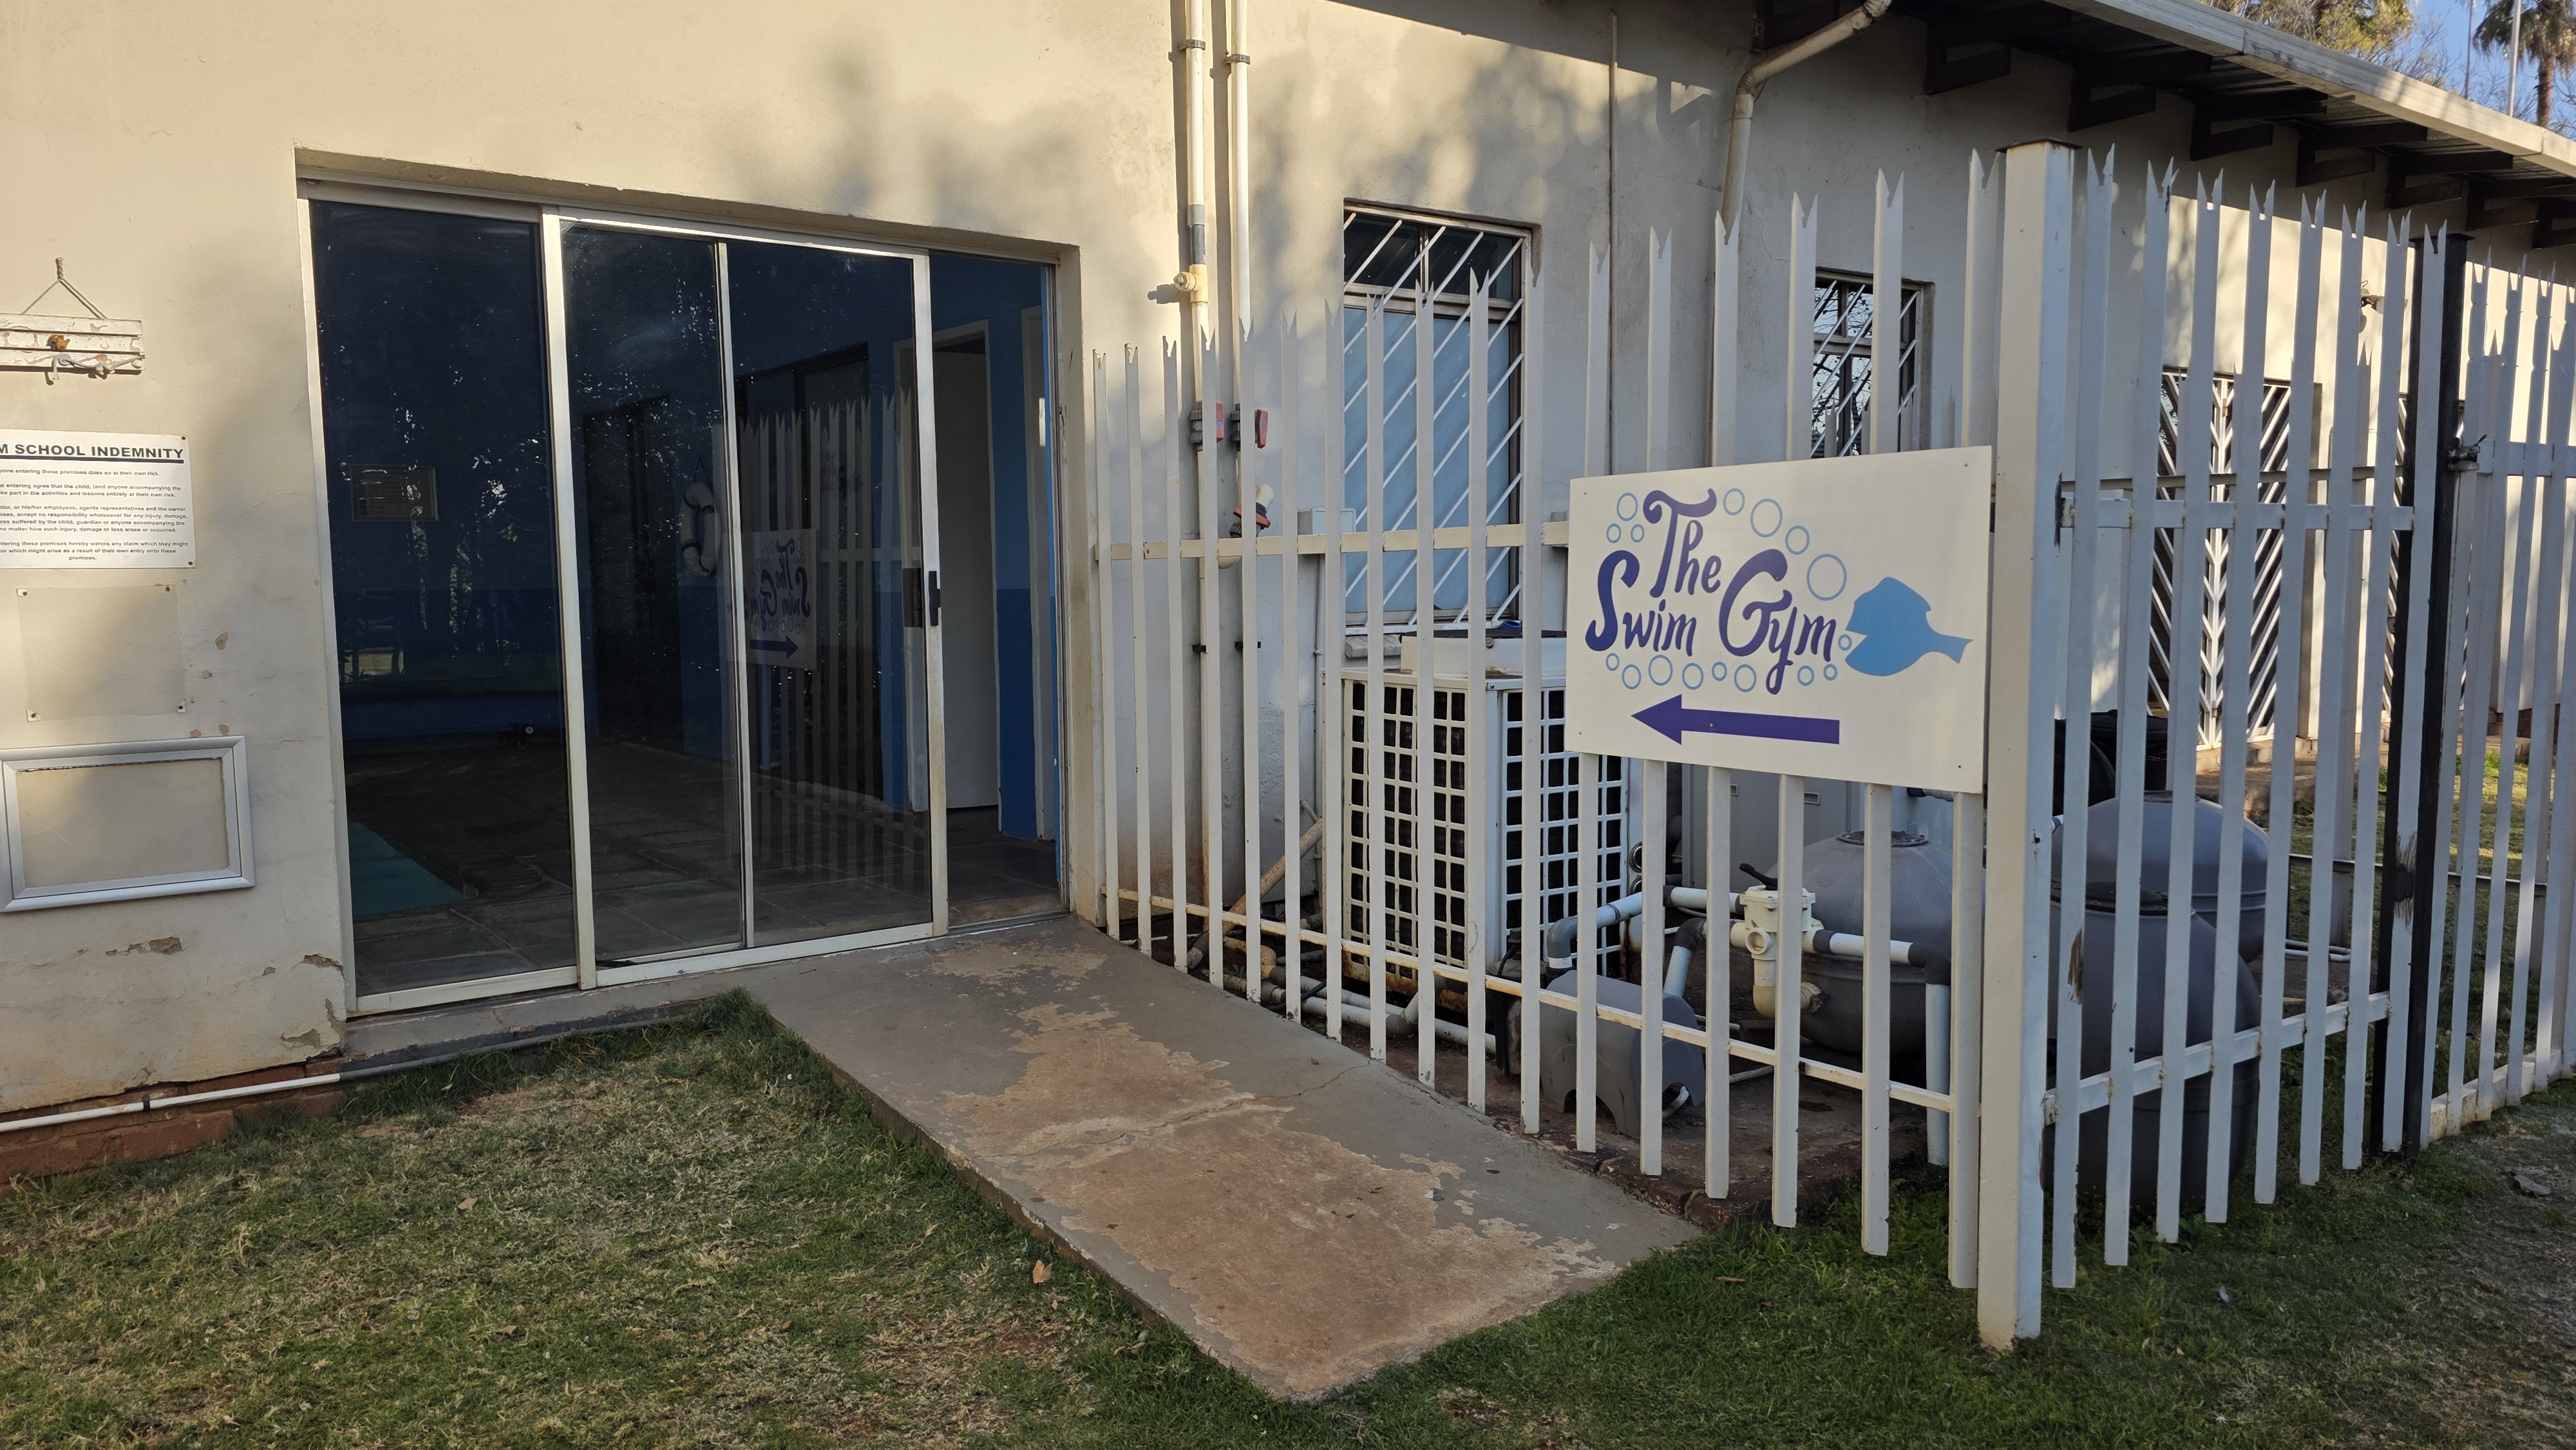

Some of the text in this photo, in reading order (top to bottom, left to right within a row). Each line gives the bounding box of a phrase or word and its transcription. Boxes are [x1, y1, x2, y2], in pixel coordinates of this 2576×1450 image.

[15, 444, 86, 456] SCHOOL
[91, 446, 184, 458] INDEMNITY
[1643, 488, 1721, 598] The
[1586, 549, 1836, 695] Swim Gym
